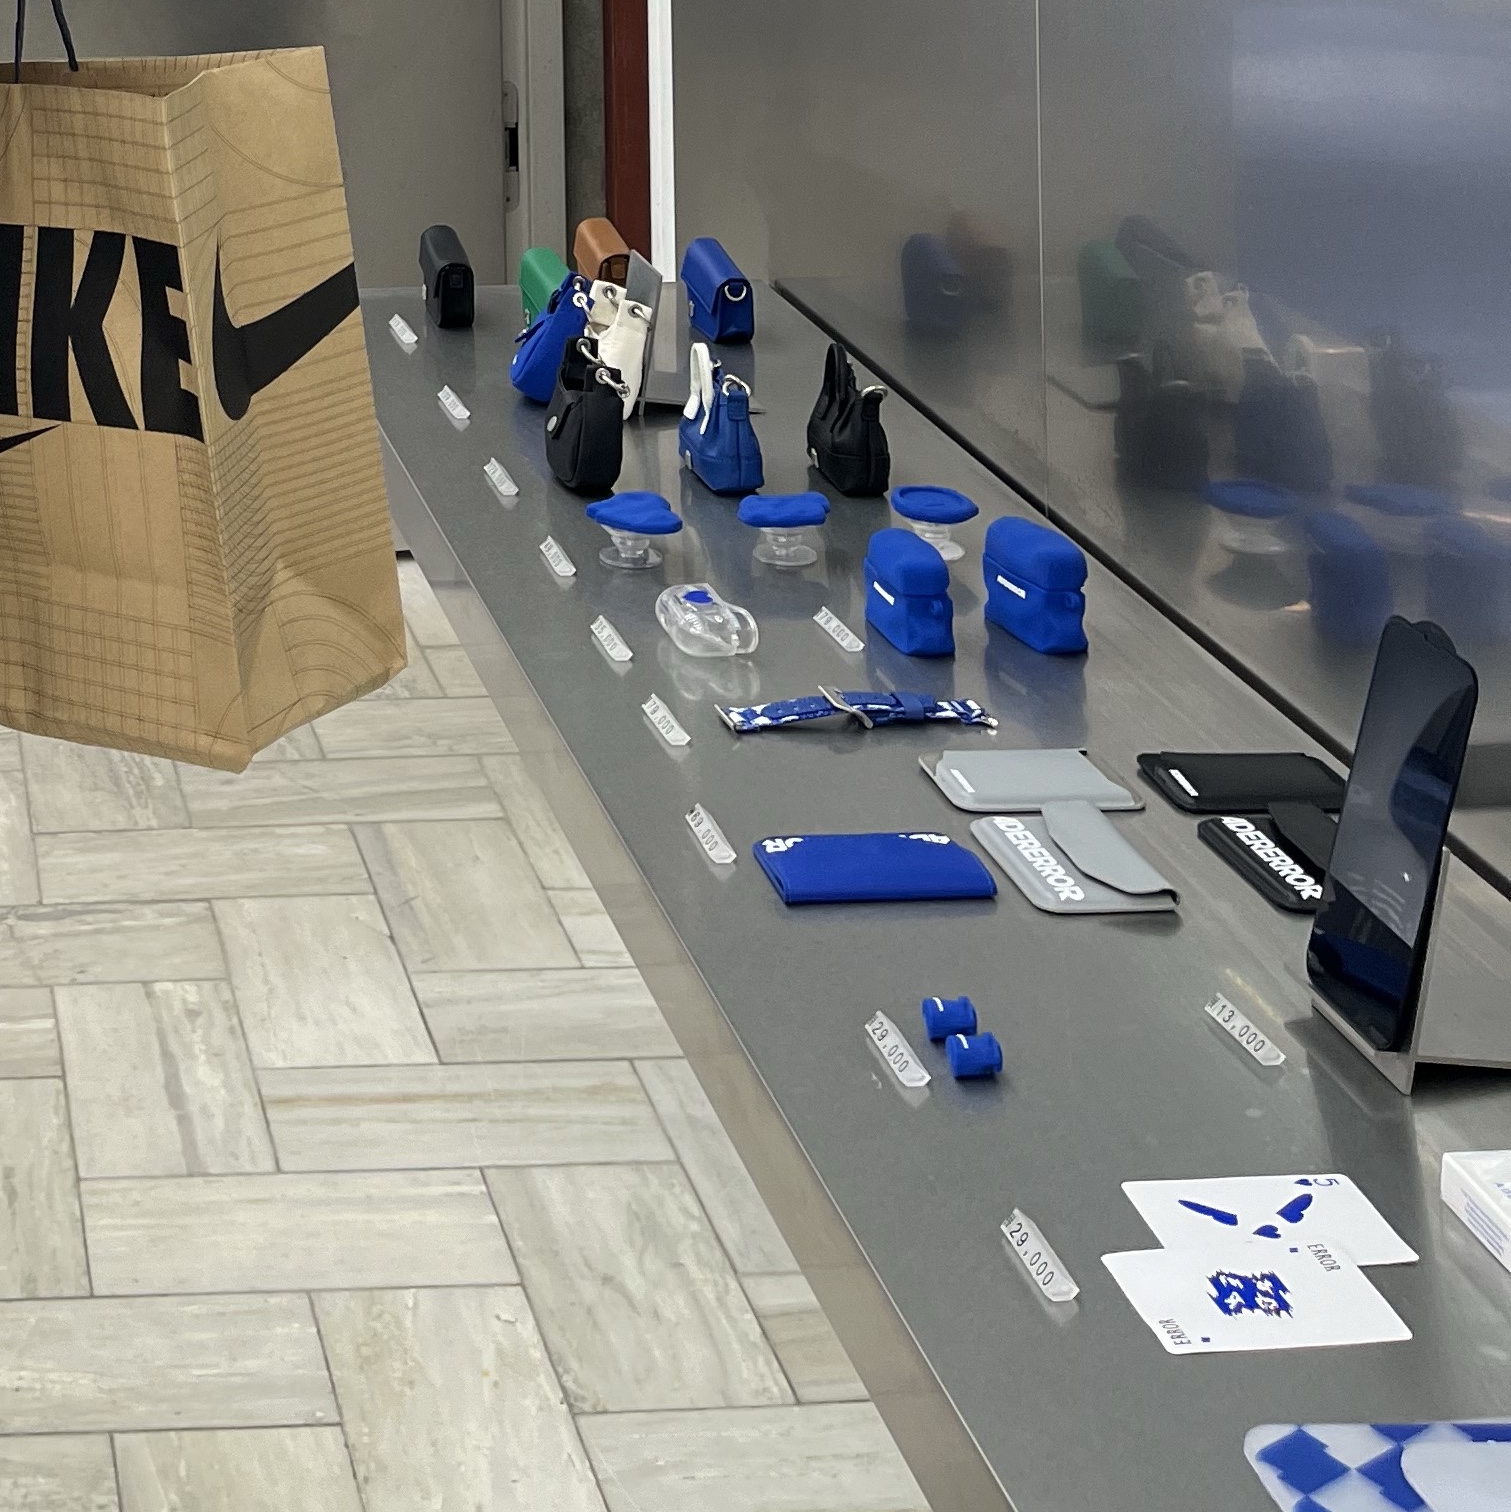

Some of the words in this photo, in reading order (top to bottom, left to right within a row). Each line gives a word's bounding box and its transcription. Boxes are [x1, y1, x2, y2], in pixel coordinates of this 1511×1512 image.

[993, 816, 1085, 901] ADERERROR
[1221, 816, 1323, 901] ADERERROR
[872, 1021, 909, 1073] 29,000
[1215, 1004, 1266, 1053] 13,000
[1313, 1178, 1341, 1187] 5
[1009, 1222, 1054, 1286] 29,000
[1307, 1243, 1341, 1272] ERROR
[1158, 1318, 1192, 1346] ERROR
